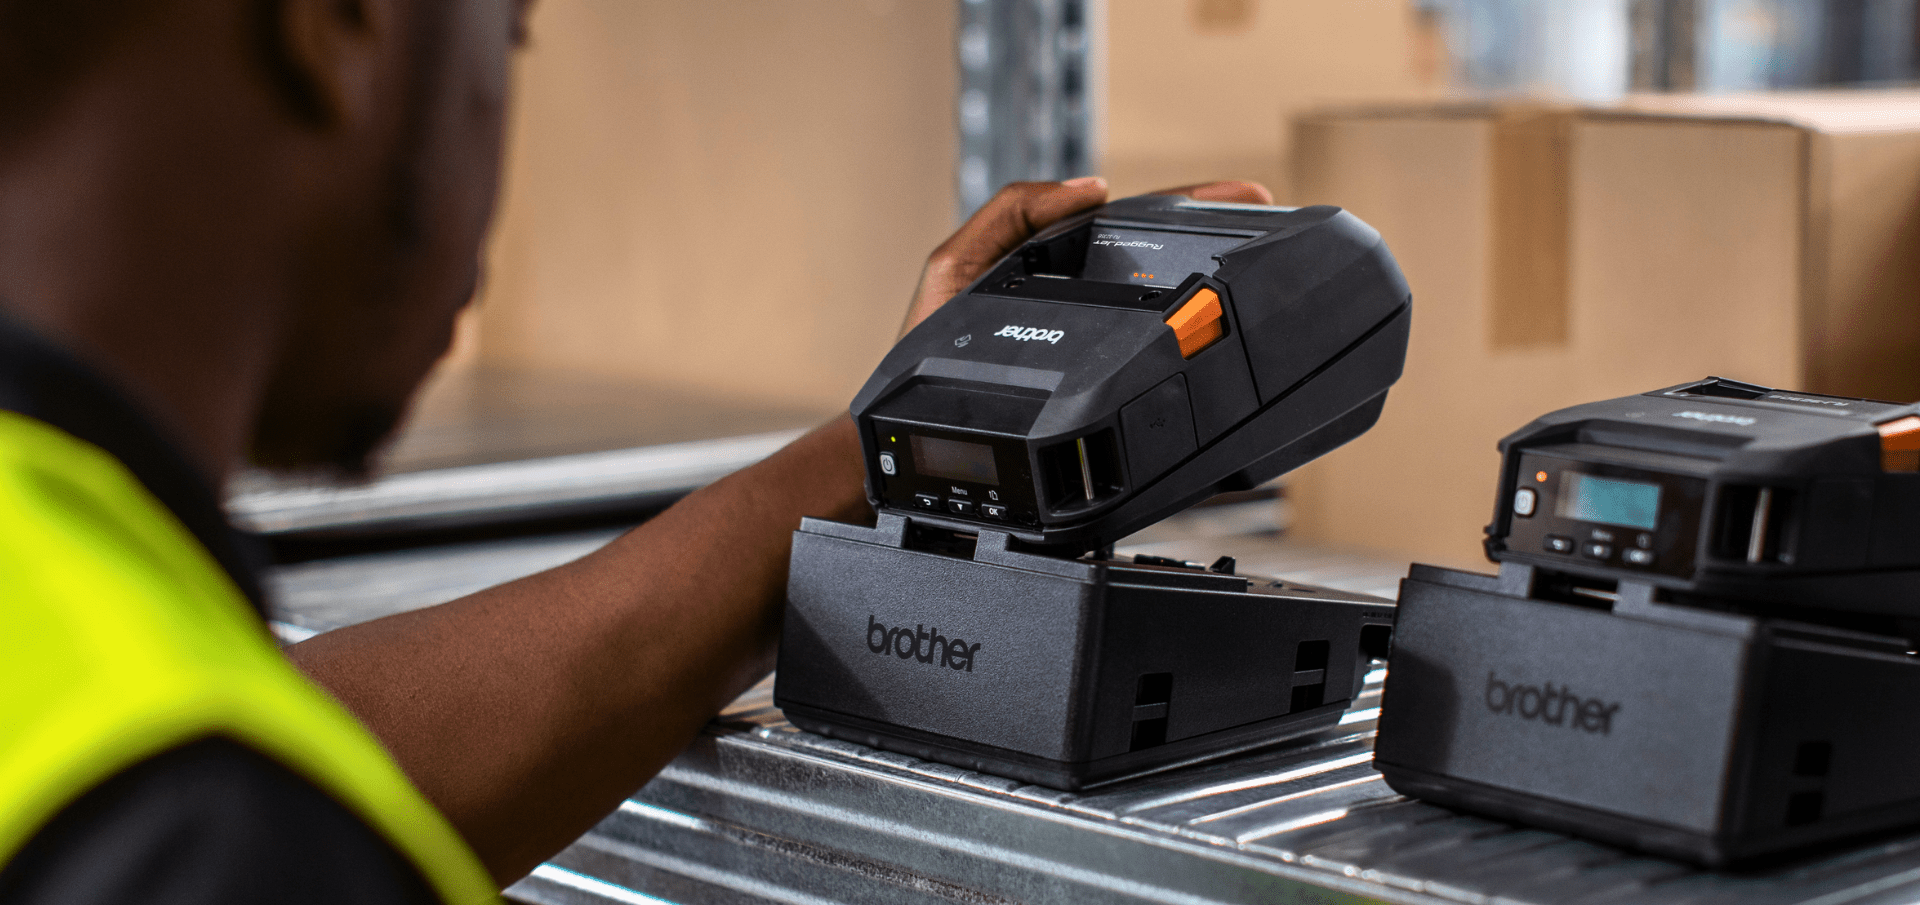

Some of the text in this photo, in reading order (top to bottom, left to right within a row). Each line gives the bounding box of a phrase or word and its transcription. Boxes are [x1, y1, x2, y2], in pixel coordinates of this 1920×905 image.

[993, 324, 1065, 345] brother
[951, 486, 968, 496] Menu
[988, 507, 999, 516] OK
[866, 614, 981, 672] brother
[1485, 671, 1621, 735] brother
